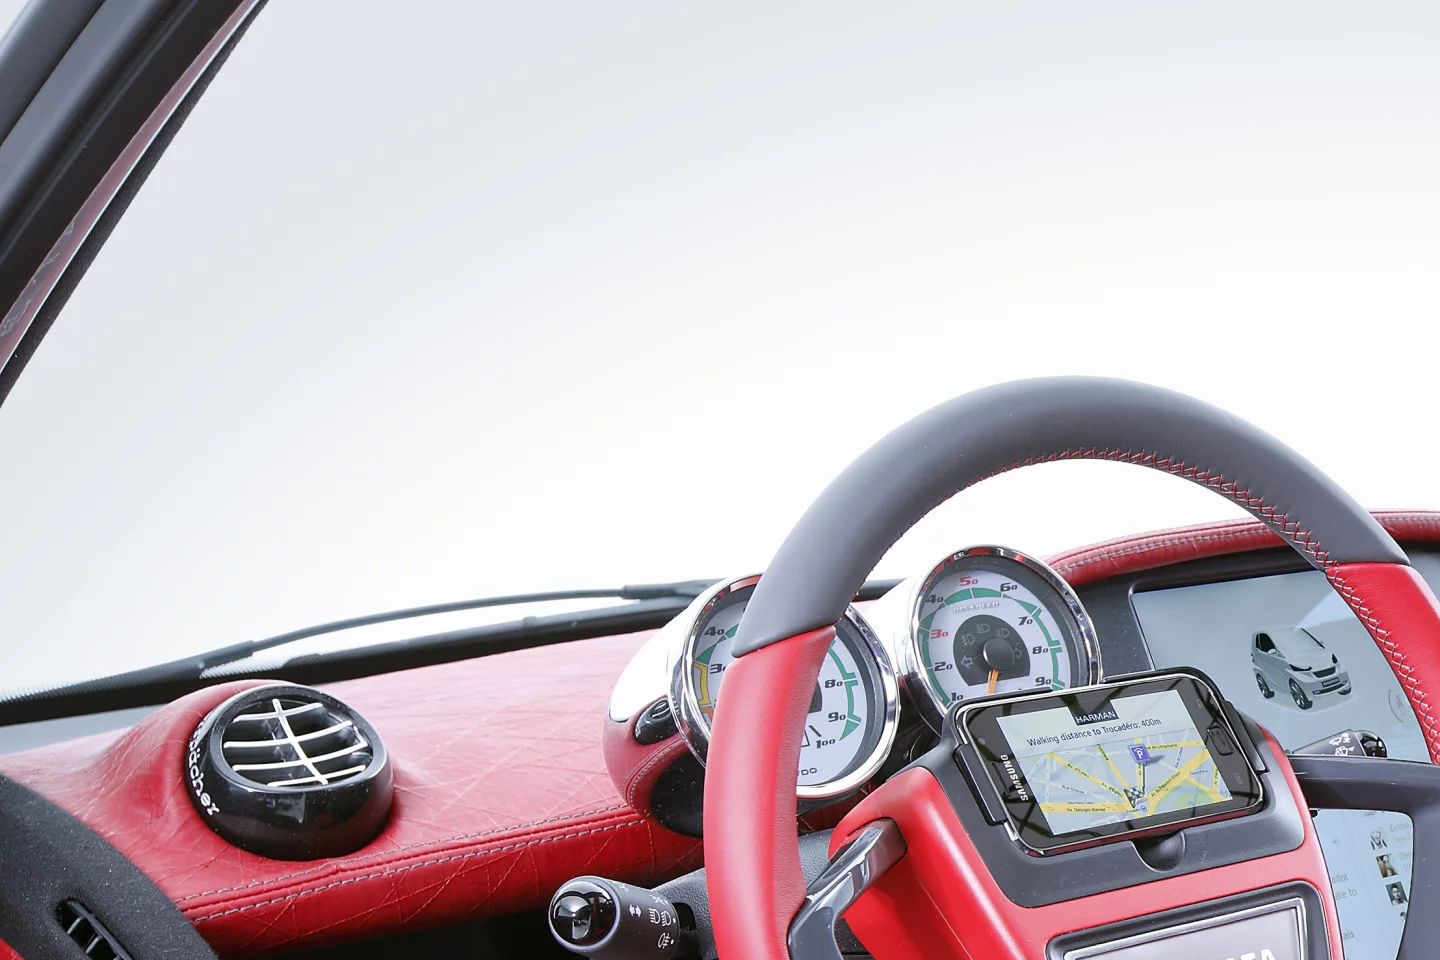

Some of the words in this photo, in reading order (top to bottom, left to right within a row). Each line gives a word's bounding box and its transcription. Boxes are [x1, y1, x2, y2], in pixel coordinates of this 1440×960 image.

[959, 576, 979, 587] 50
[1000, 582, 1018, 592] 60
[926, 594, 944, 604] 40
[1018, 615, 1033, 626] 70
[703, 626, 725, 636] 40
[930, 628, 949, 639] 30
[1032, 645, 1049, 655] 80
[934, 661, 953, 672] 20
[824, 679, 843, 689] 80
[1035, 676, 1052, 686] 90
[950, 692, 964, 702] 10
[827, 711, 846, 723] 90
[1075, 710, 1116, 723] HARMAN
[1026, 736, 1060, 746] Walking
[1060, 730, 1092, 741] distance
[1092, 728, 1102, 736] to
[1141, 718, 1162, 727] 400m
[815, 738, 836, 749] 100
[797, 767, 818, 776] DO
[1000, 754, 1029, 801] SAMSUNG
[1348, 888, 1358, 898] to
